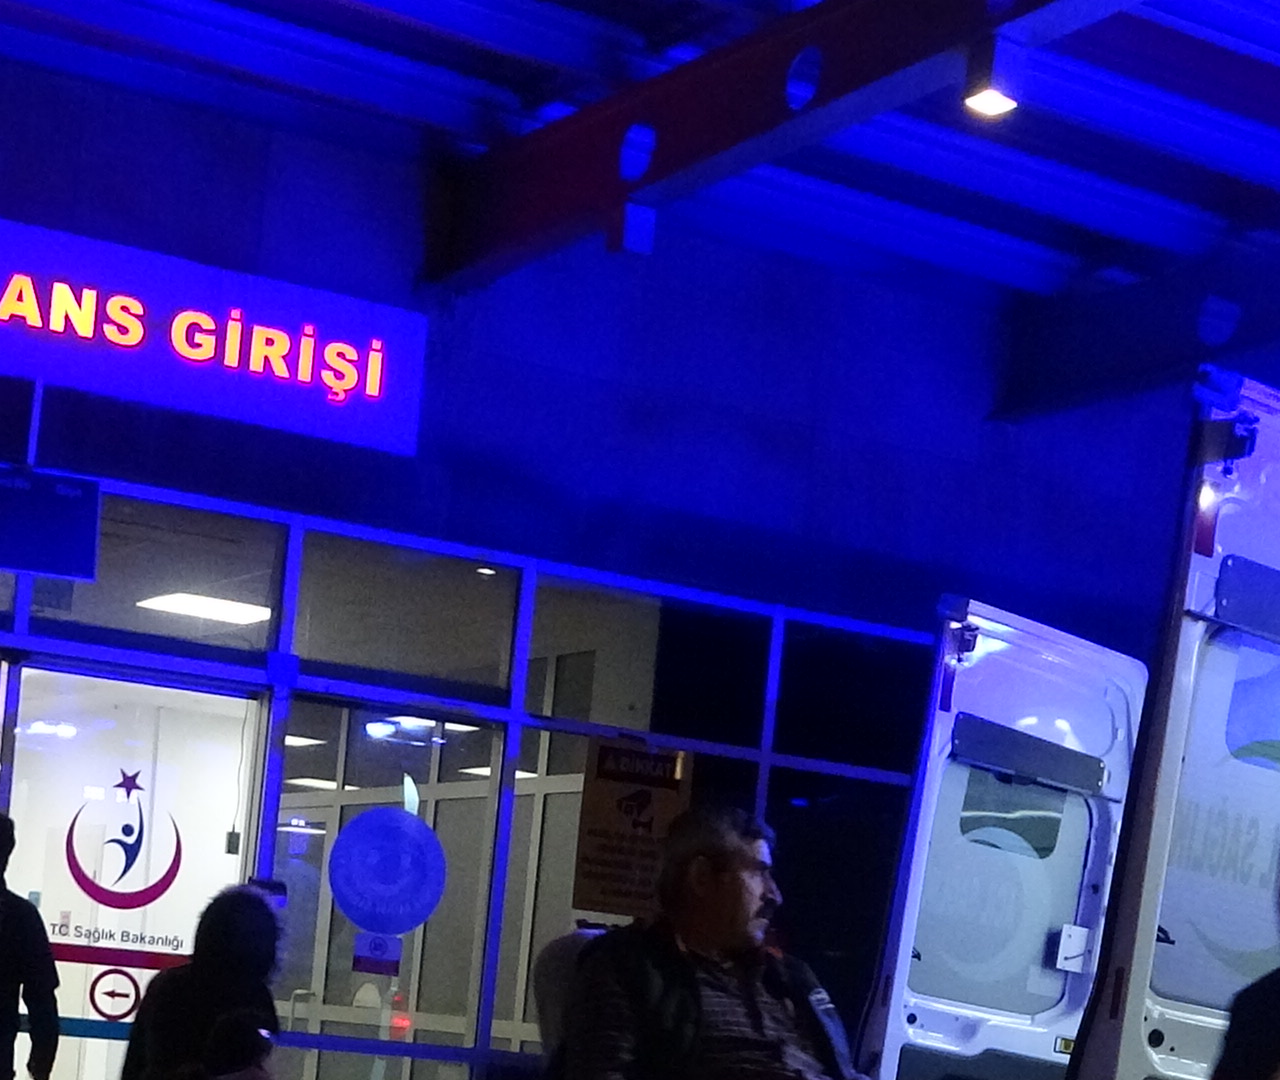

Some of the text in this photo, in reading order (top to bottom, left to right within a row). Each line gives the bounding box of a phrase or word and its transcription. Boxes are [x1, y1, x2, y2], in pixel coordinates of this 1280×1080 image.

[169, 307, 384, 402] GİRİŞİ
[74, 925, 116, 943] Sağlık
[121, 930, 184, 950] Bakanlığı
